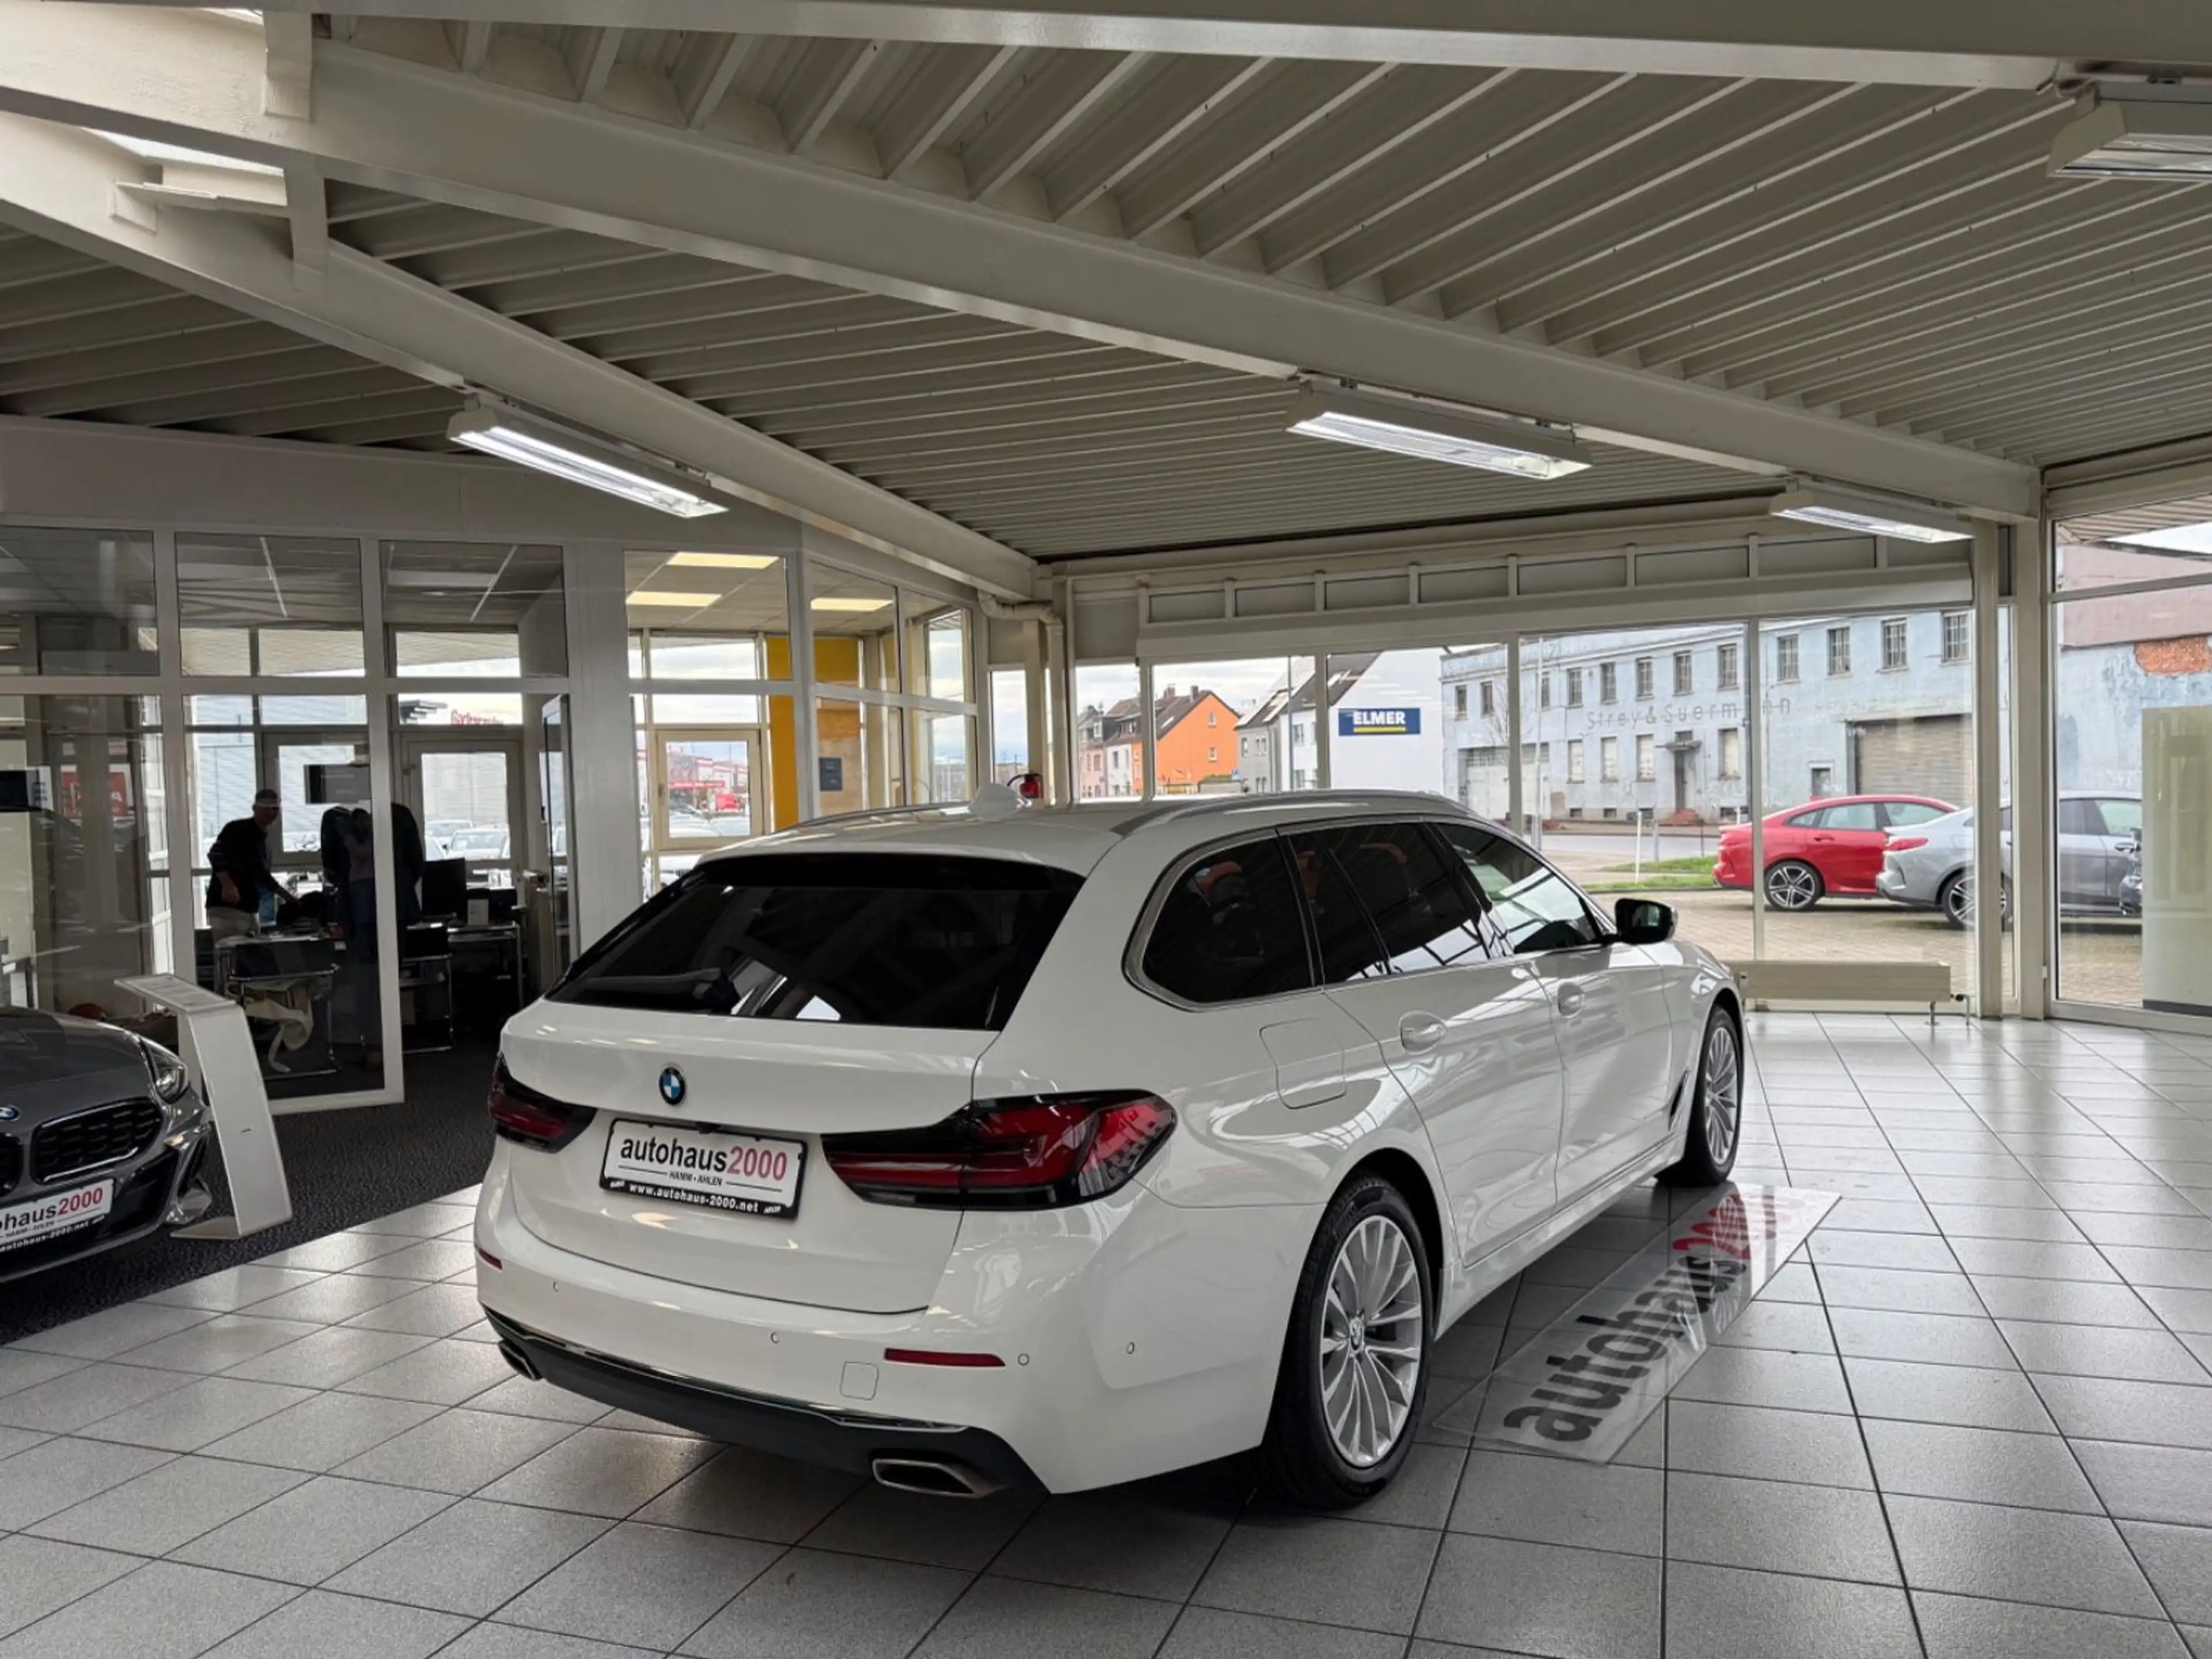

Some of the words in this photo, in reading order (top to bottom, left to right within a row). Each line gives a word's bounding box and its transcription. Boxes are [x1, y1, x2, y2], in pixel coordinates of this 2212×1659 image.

[1353, 711, 1406, 725] ELMER
[620, 1137, 787, 1181] autohaus2000
[0, 1187, 103, 1230] haus2000
